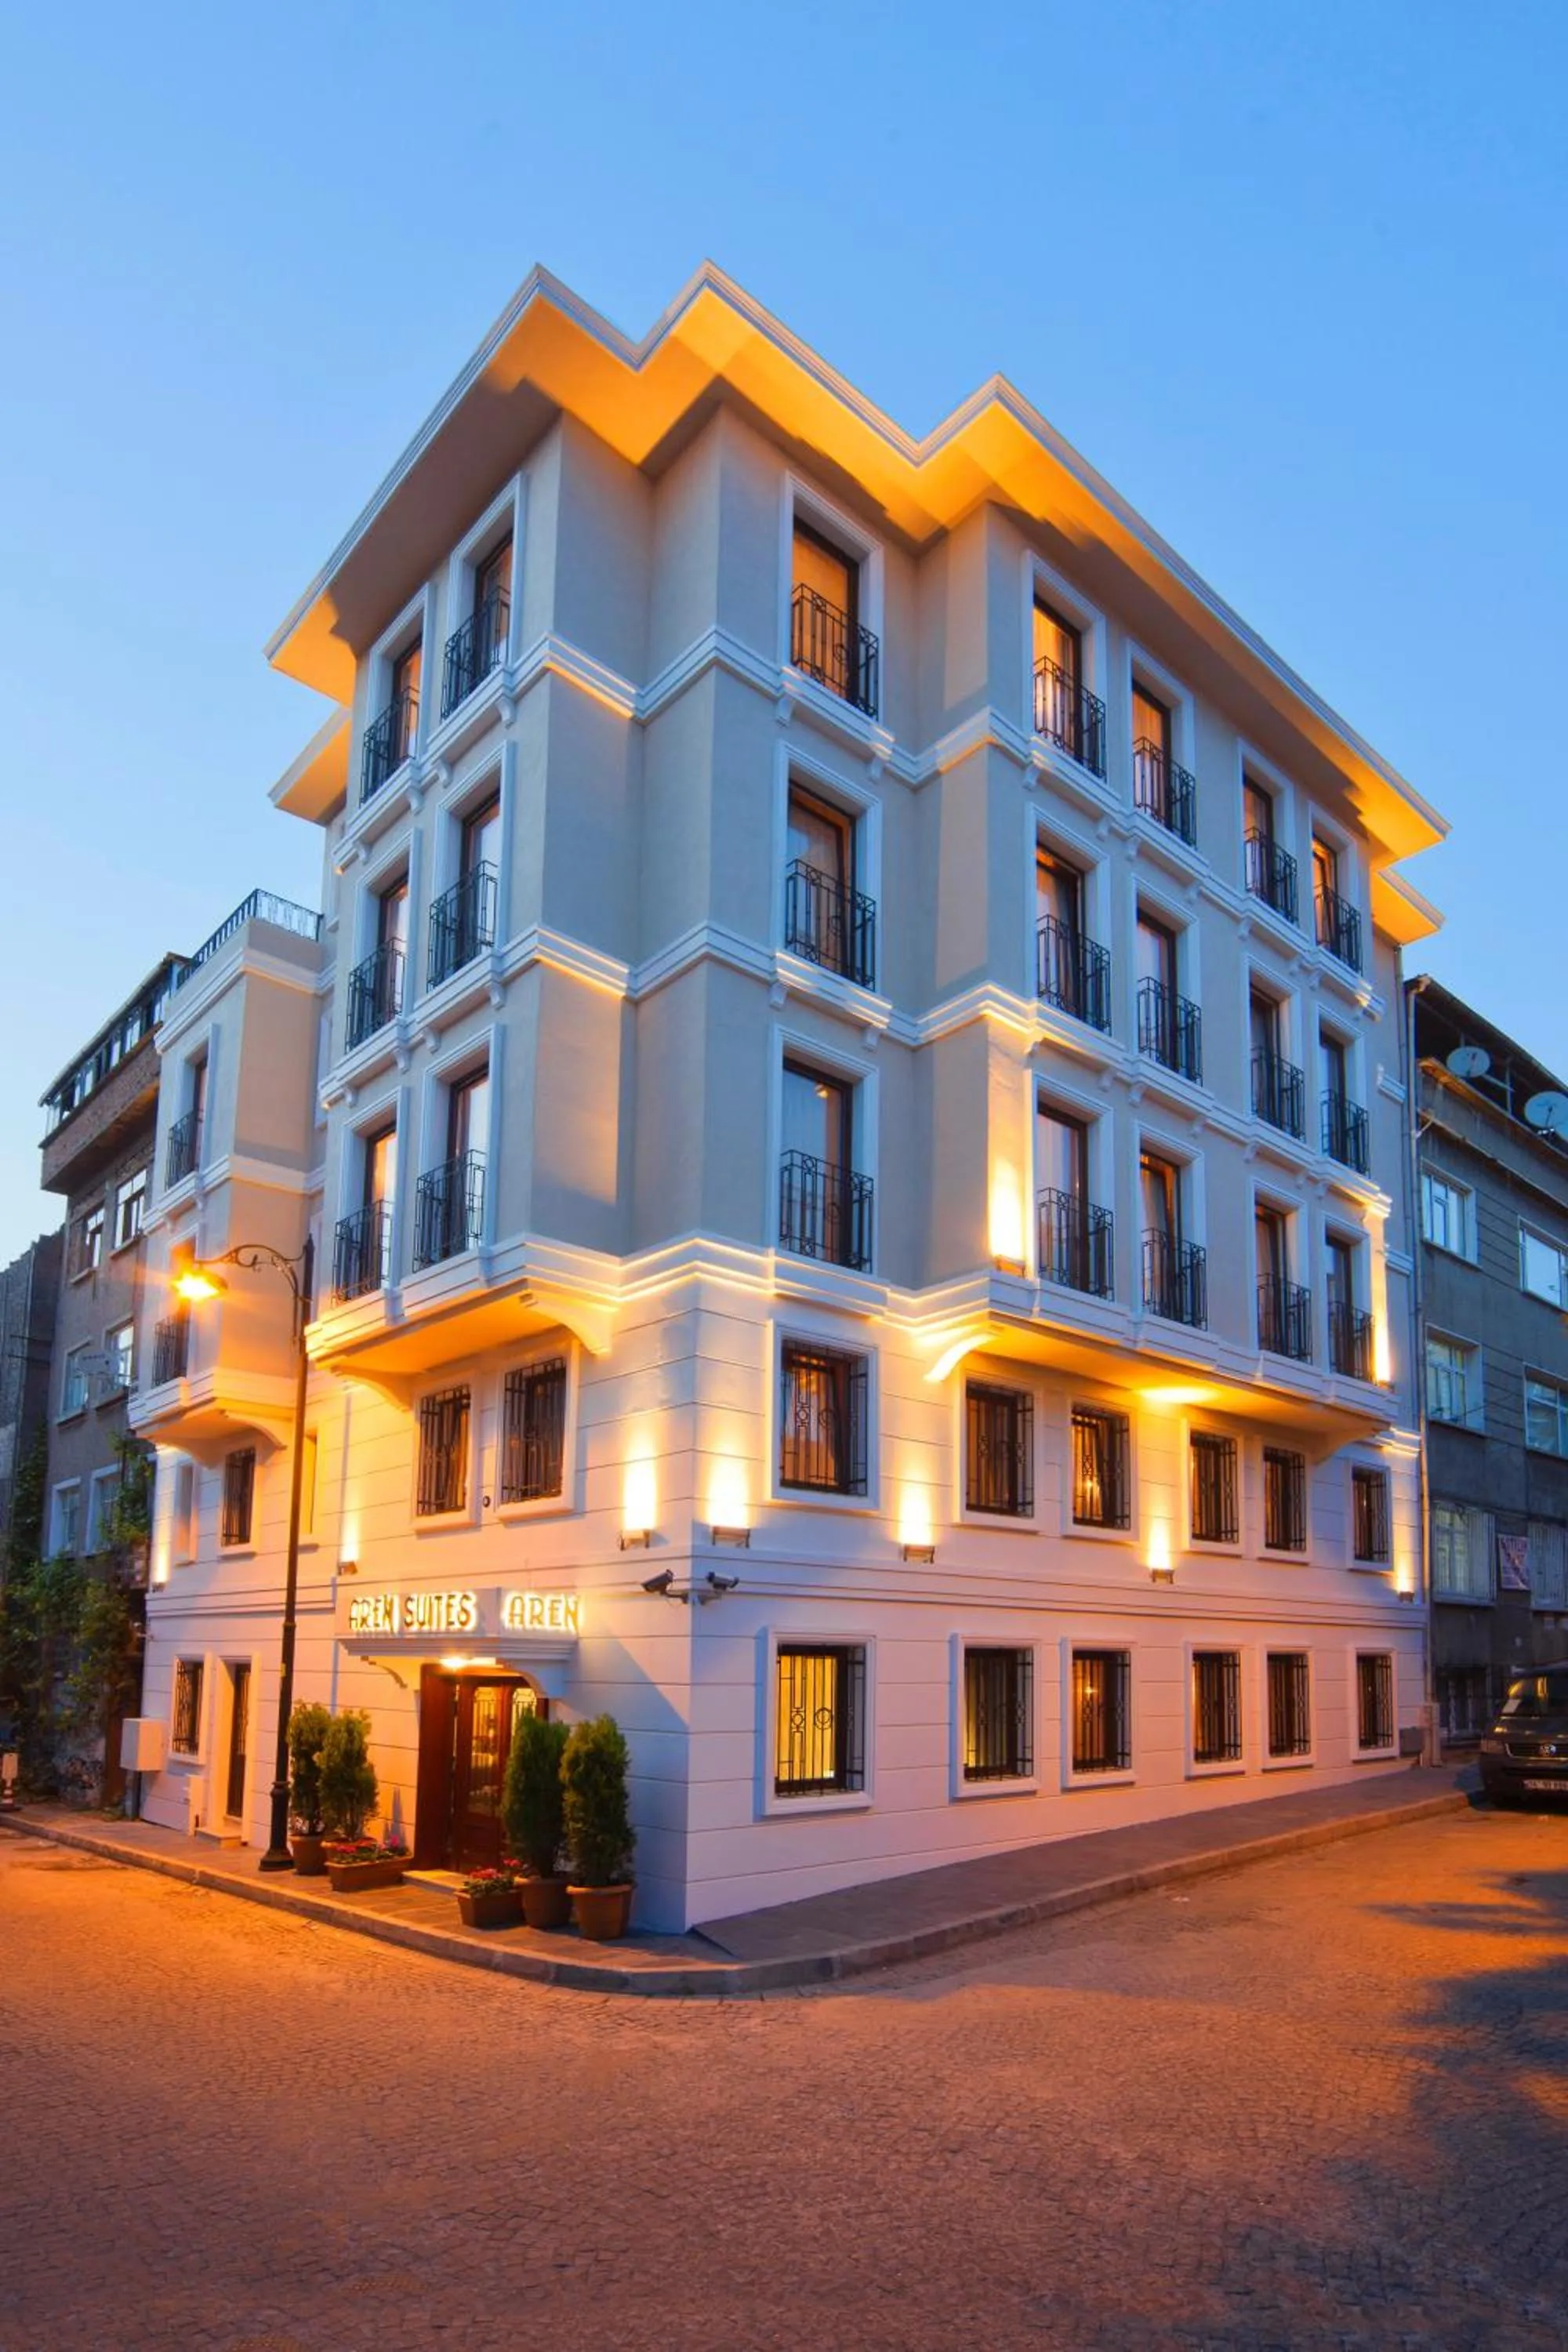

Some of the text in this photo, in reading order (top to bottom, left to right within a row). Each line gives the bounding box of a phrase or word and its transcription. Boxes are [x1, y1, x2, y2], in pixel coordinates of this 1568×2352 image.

[349, 1594, 473, 1633] AREN SUITES
[507, 1594, 580, 1632] AREN
